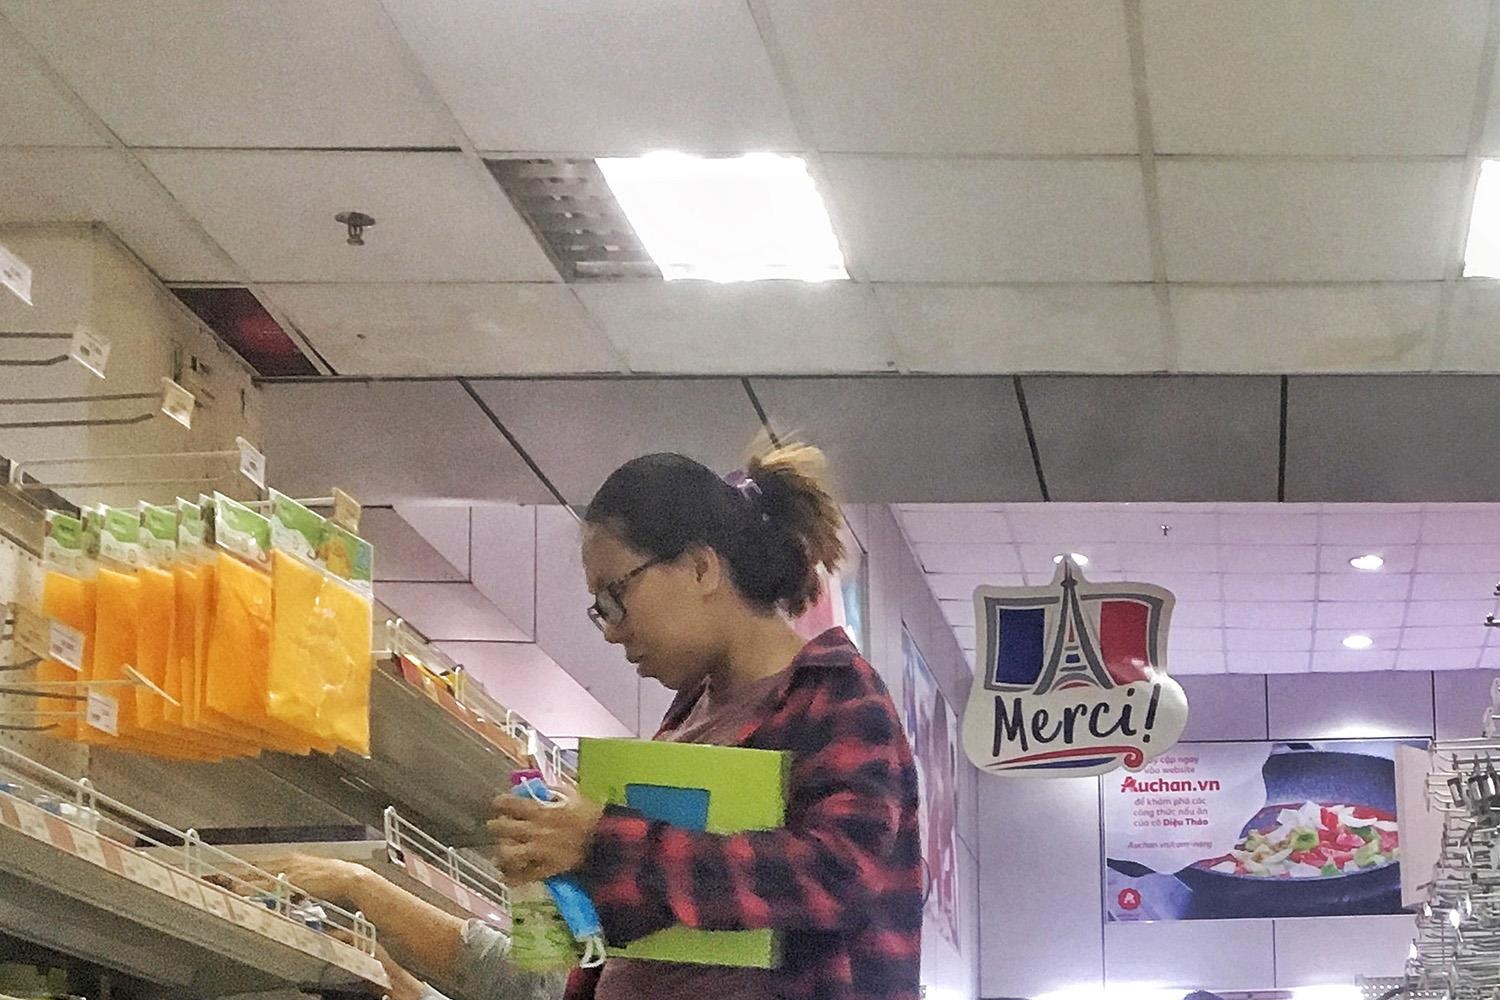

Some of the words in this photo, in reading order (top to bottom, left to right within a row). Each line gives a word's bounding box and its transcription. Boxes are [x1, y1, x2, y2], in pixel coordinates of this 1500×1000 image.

[992, 683, 1162, 757] Merci!
[1162, 765, 1195, 774] website
[1121, 776, 1221, 793] Auchan.vn
